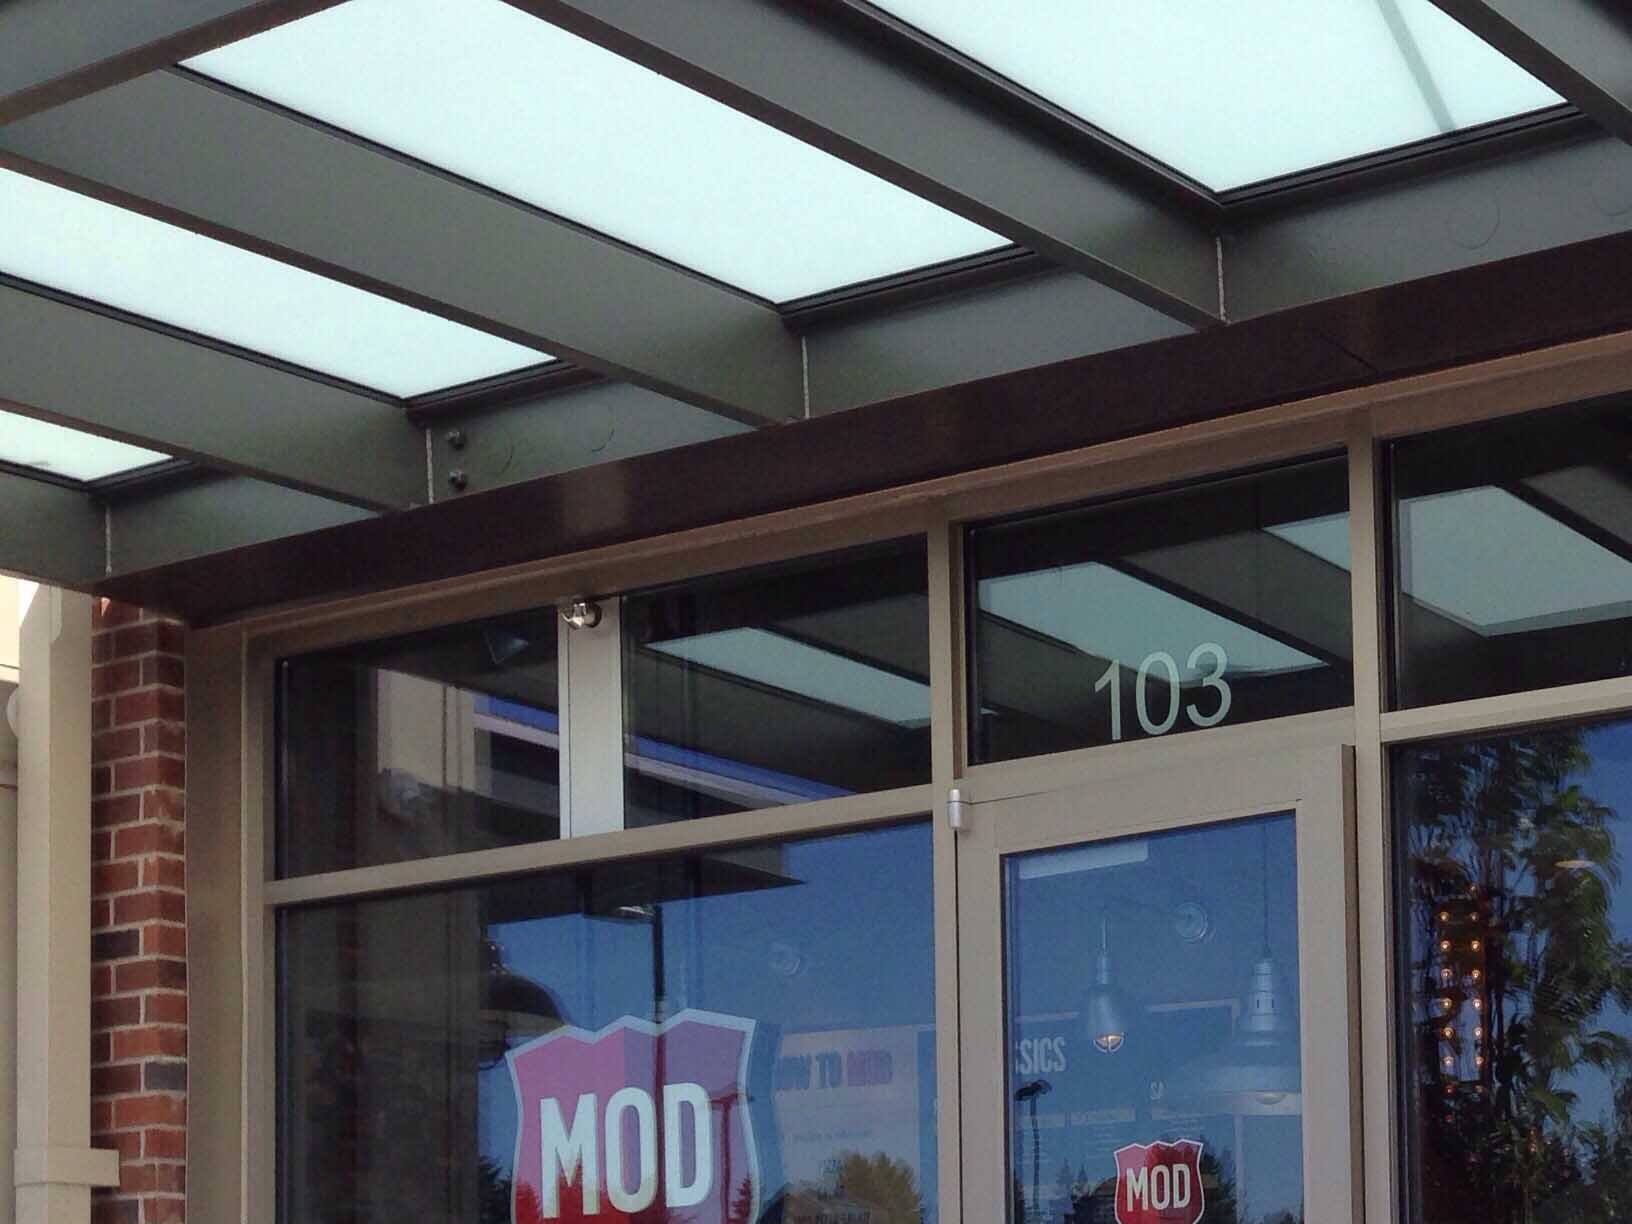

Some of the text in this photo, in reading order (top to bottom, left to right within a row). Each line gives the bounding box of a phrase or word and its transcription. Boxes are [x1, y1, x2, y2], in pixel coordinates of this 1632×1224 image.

[1094, 641, 1233, 741] 103
[539, 1082, 714, 1219] MOD
[1125, 1162, 1192, 1214] MOD
